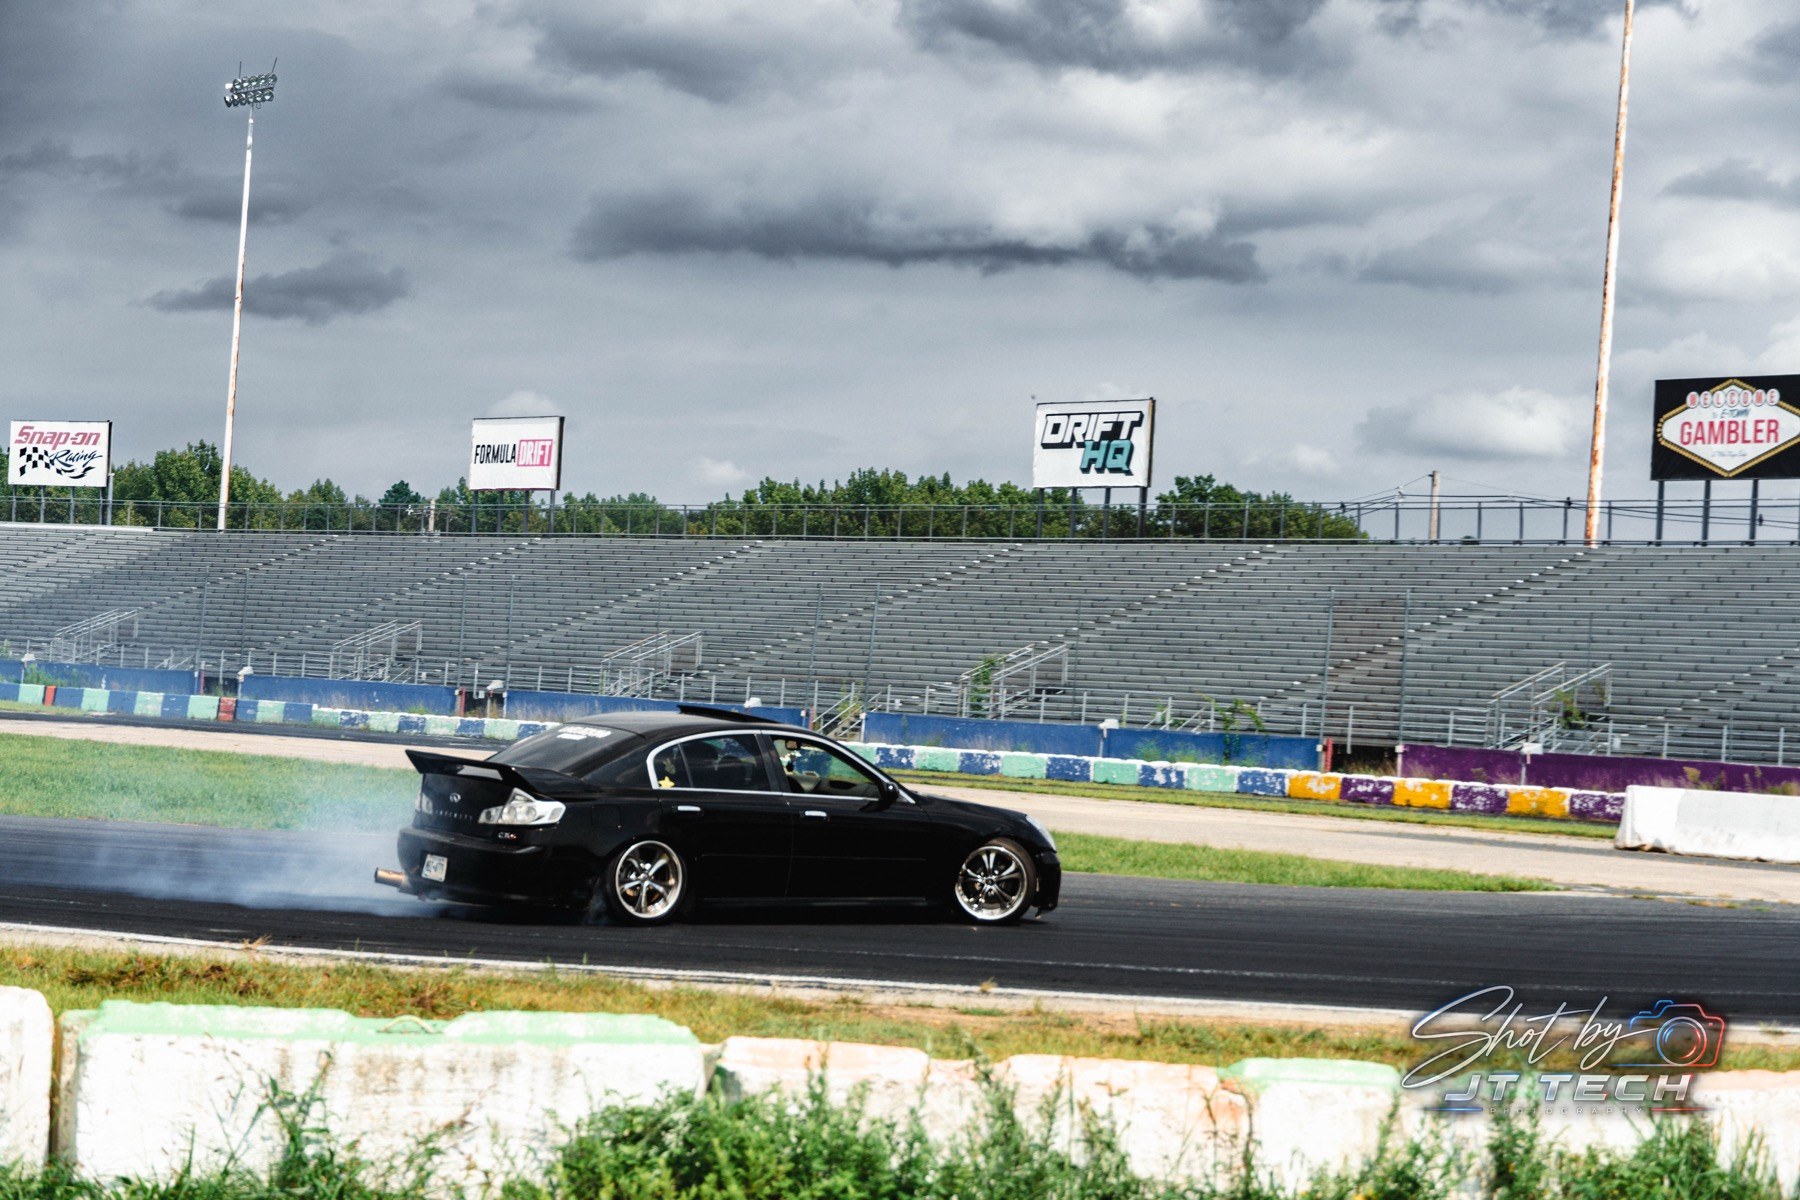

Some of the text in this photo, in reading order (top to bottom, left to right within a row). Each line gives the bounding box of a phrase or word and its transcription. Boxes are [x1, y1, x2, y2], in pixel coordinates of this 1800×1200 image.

[14, 425, 101, 450] Snap-on
[1041, 411, 1144, 449] DRIFT
[1680, 419, 1779, 446] GAMBLER
[49, 449, 102, 468] Racing
[474, 441, 552, 465] FORMULA DRIFT
[1080, 440, 1134, 476] HQ
